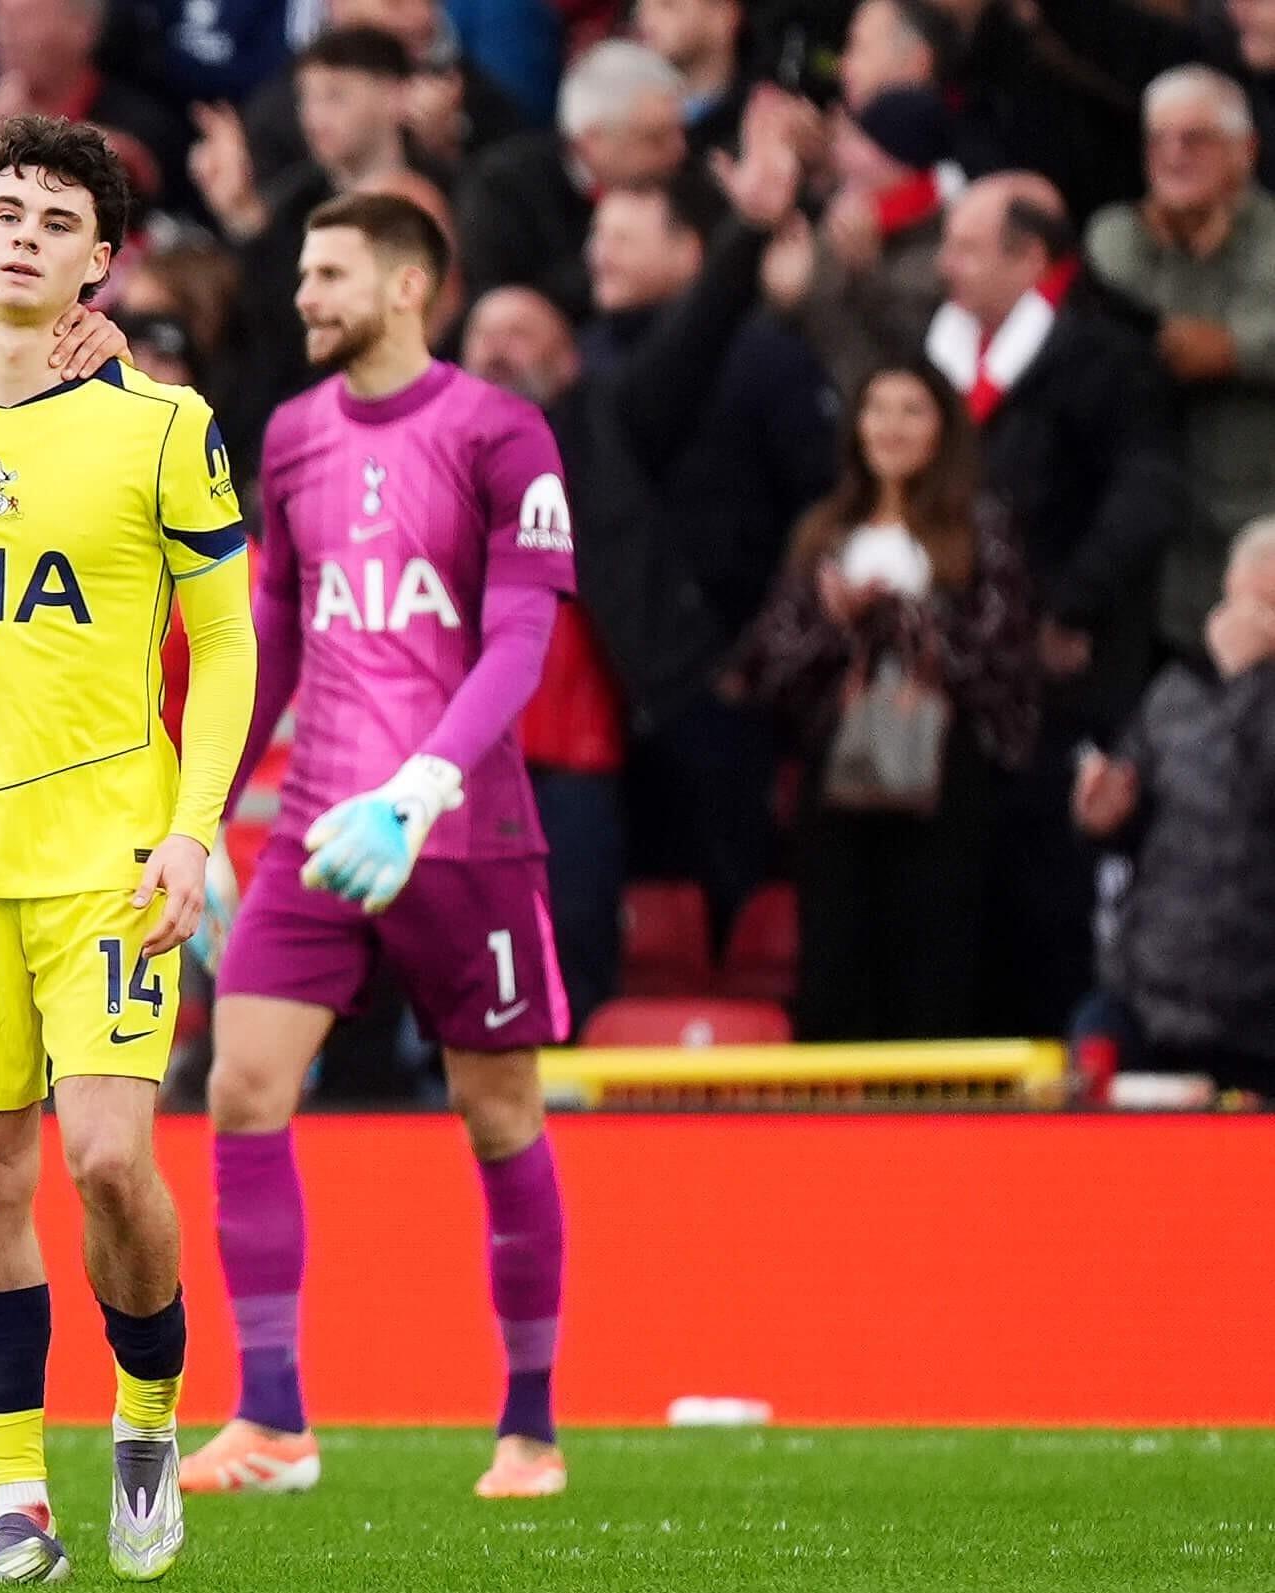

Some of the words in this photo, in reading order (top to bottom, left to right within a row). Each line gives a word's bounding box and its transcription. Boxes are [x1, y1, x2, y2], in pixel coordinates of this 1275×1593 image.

[312, 557, 462, 632] AIA
[99, 938, 163, 1018] 14
[487, 929, 517, 1004] 1
